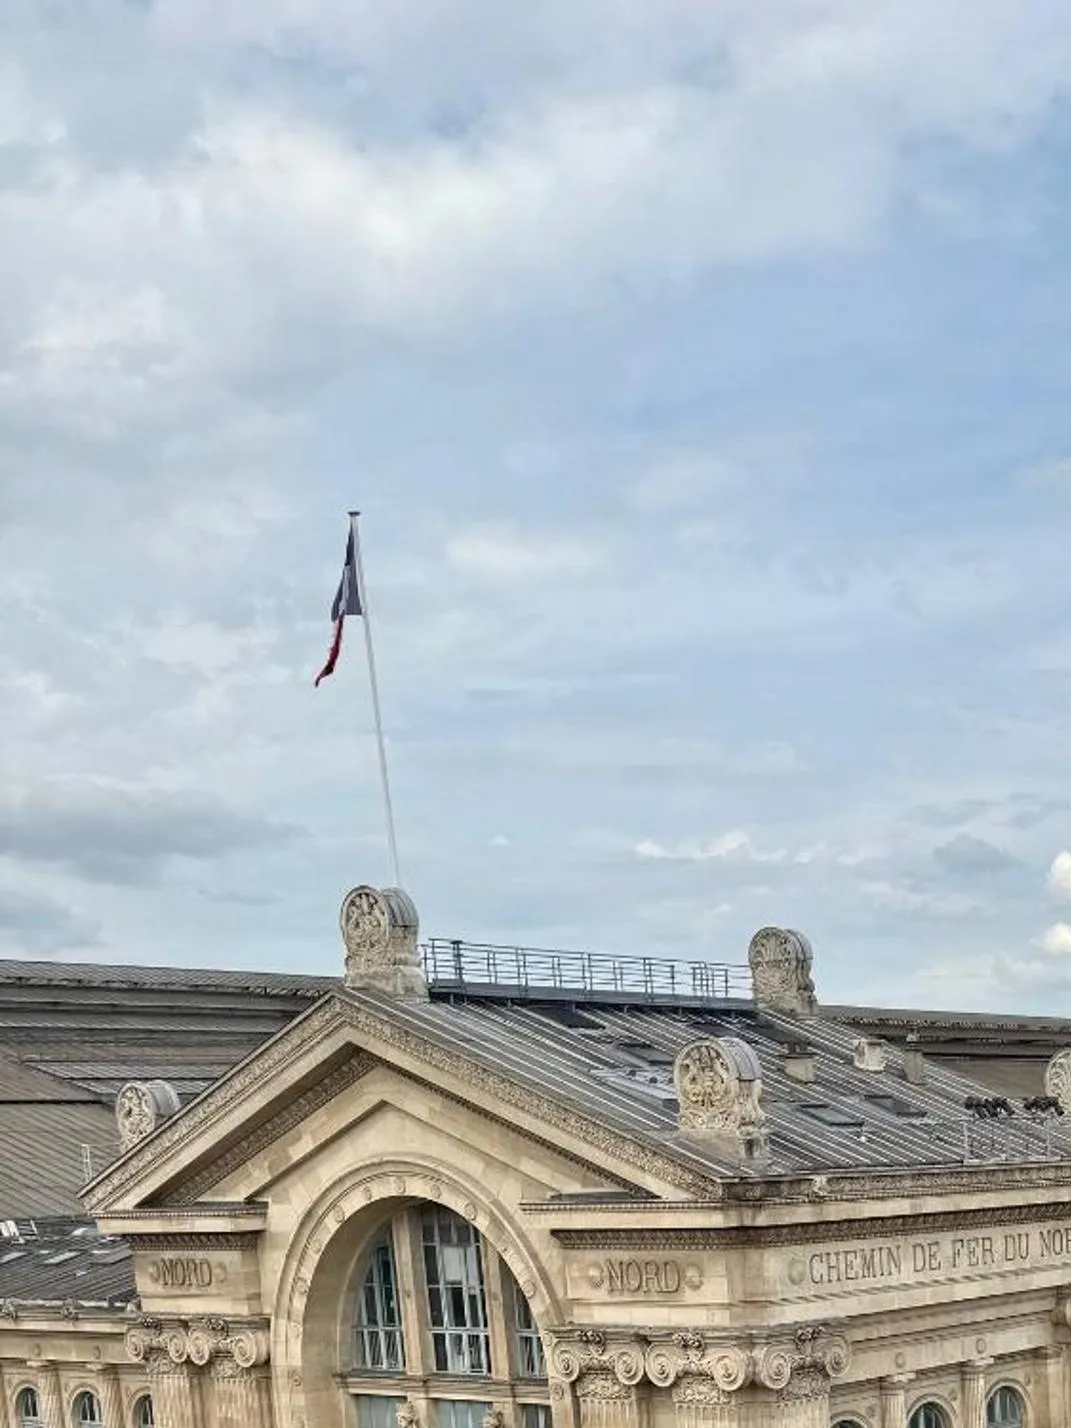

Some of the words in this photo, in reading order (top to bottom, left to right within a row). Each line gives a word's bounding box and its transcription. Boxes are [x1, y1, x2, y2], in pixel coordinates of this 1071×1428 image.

[161, 1258, 212, 1287] NORD
[809, 1245, 901, 1284] CHEMIN
[912, 1241, 941, 1273] DE
[951, 1237, 995, 1268] FER
[1004, 1233, 1029, 1261] DU
[605, 1259, 681, 1293] NORD
